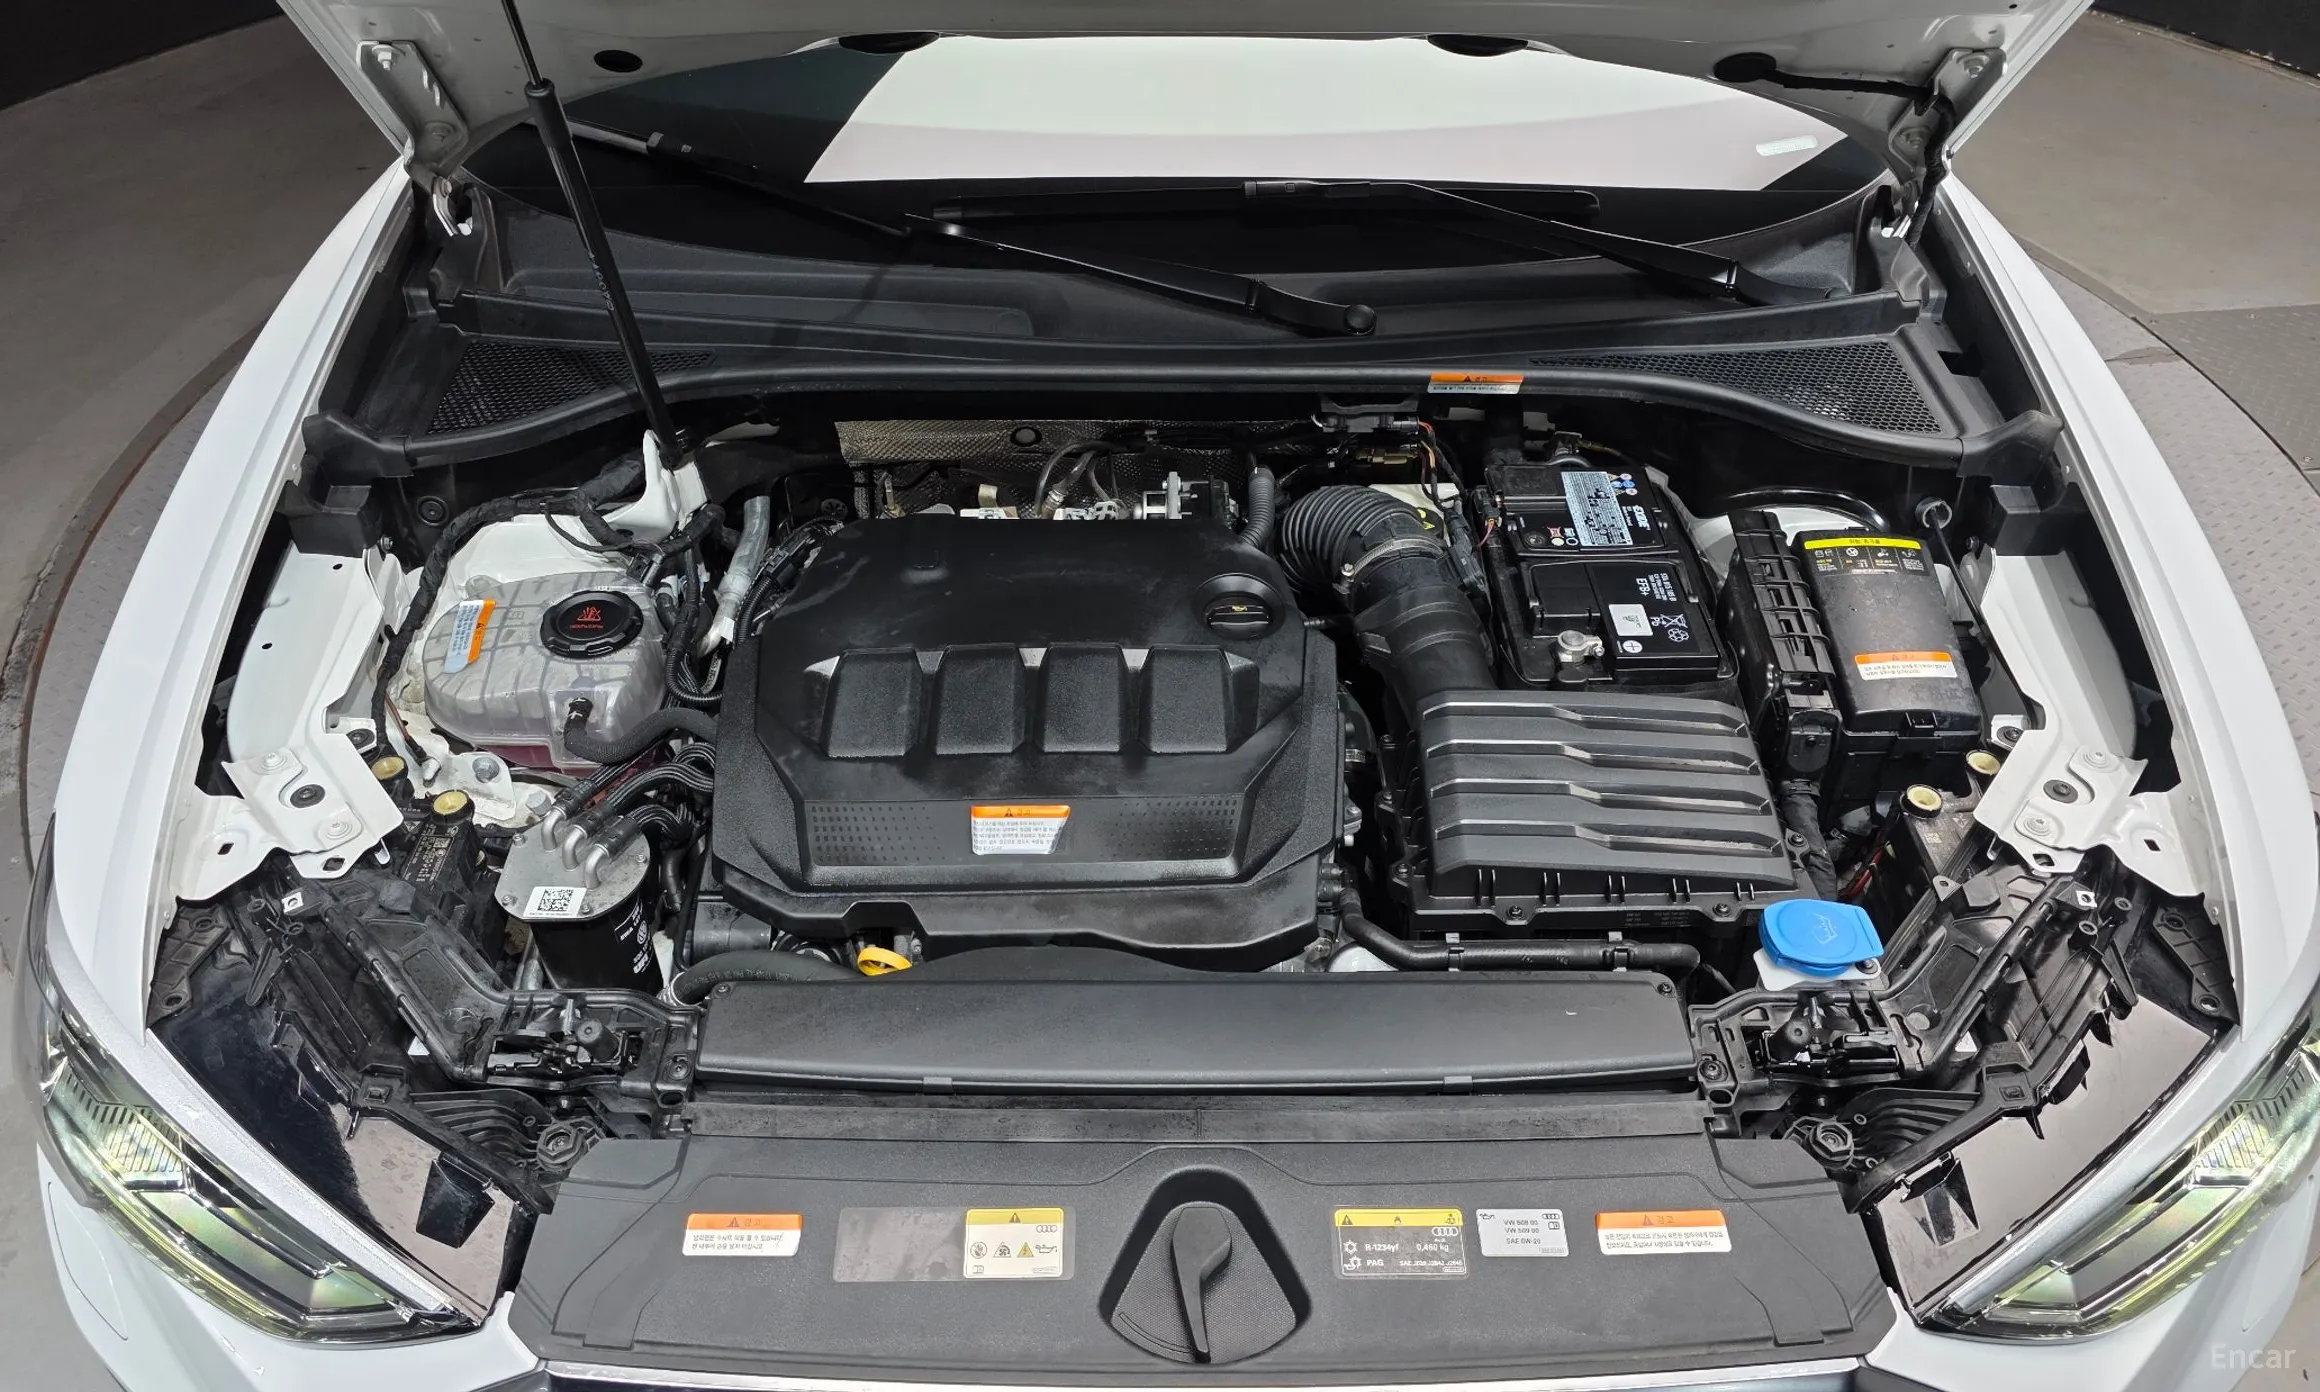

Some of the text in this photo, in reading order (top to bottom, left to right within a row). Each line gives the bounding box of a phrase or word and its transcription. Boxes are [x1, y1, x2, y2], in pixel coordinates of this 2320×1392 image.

[1635, 578, 1651, 597] EFB+
[1650, 616, 1661, 627] Pb
[1364, 1243, 1399, 1253] R-1234yf
[1439, 1243, 1449, 1253] kg
[1366, 1259, 1384, 1267] PAG
